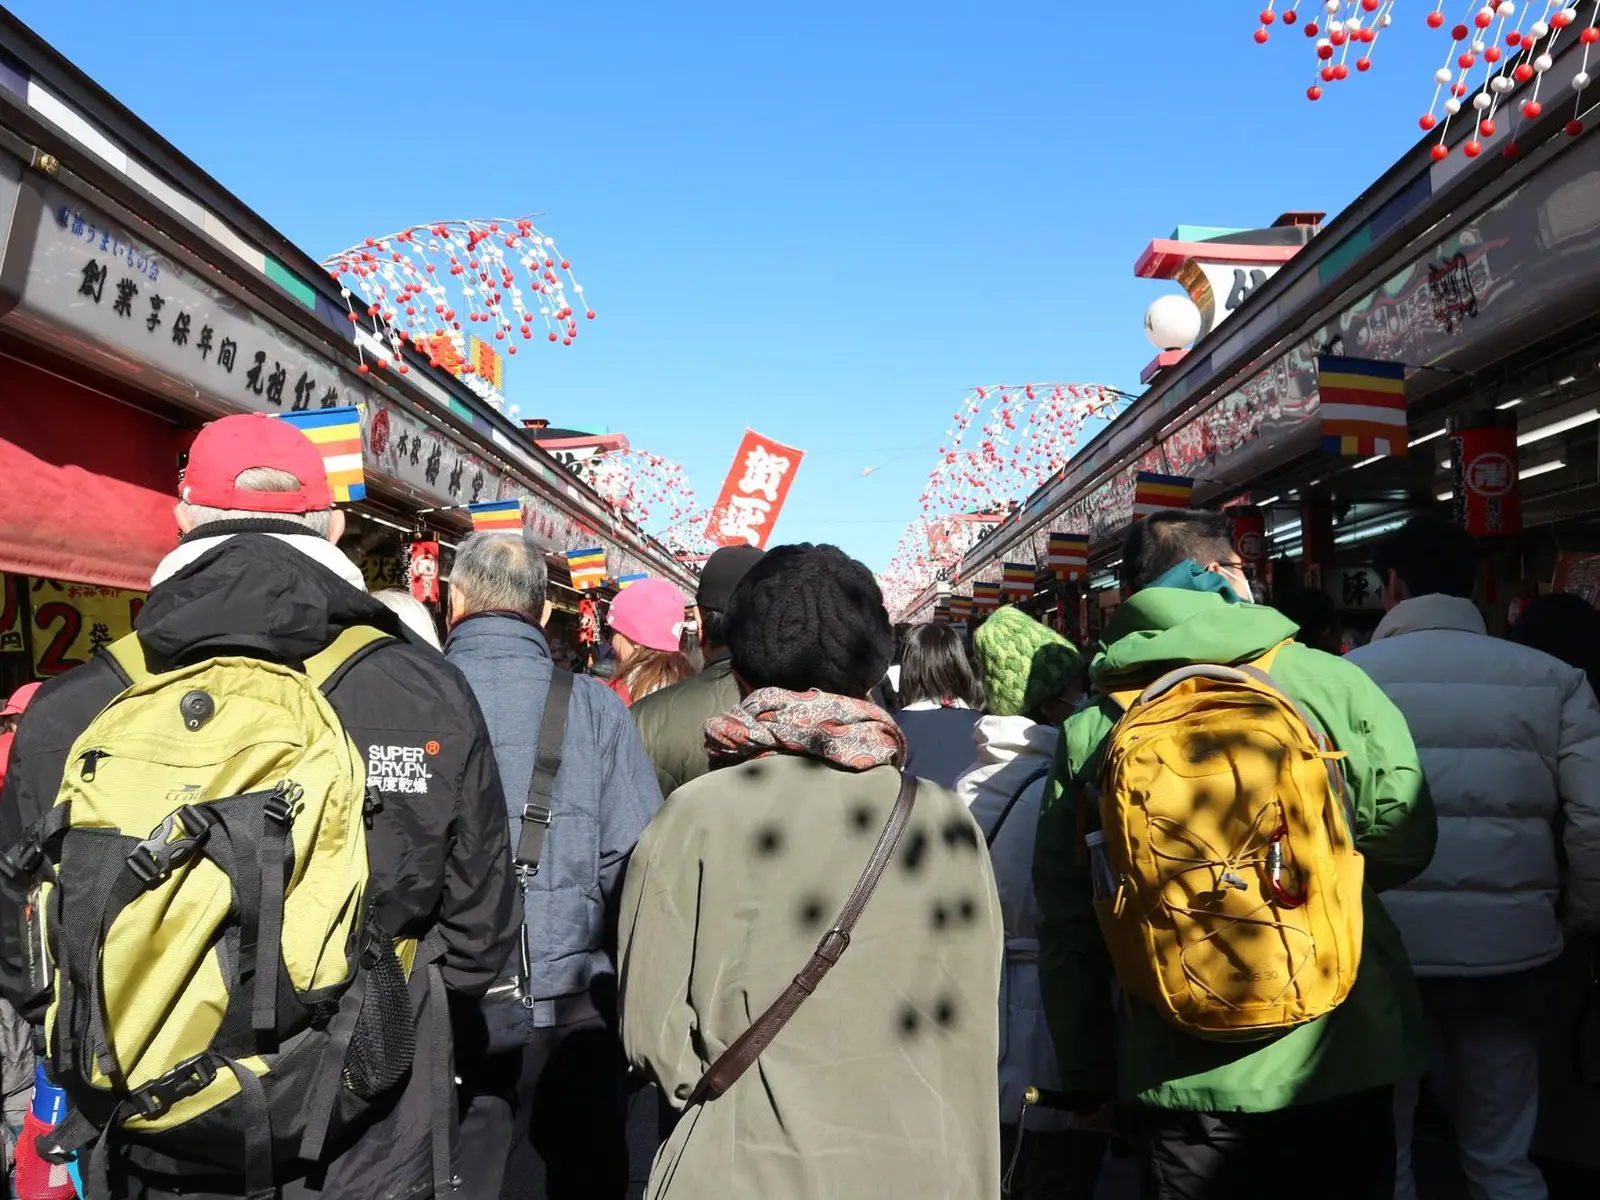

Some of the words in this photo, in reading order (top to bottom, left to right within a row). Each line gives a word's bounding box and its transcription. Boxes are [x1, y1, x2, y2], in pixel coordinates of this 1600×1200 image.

[77, 258, 238, 374] 創業享保年間
[368, 744, 425, 763] SUPER
